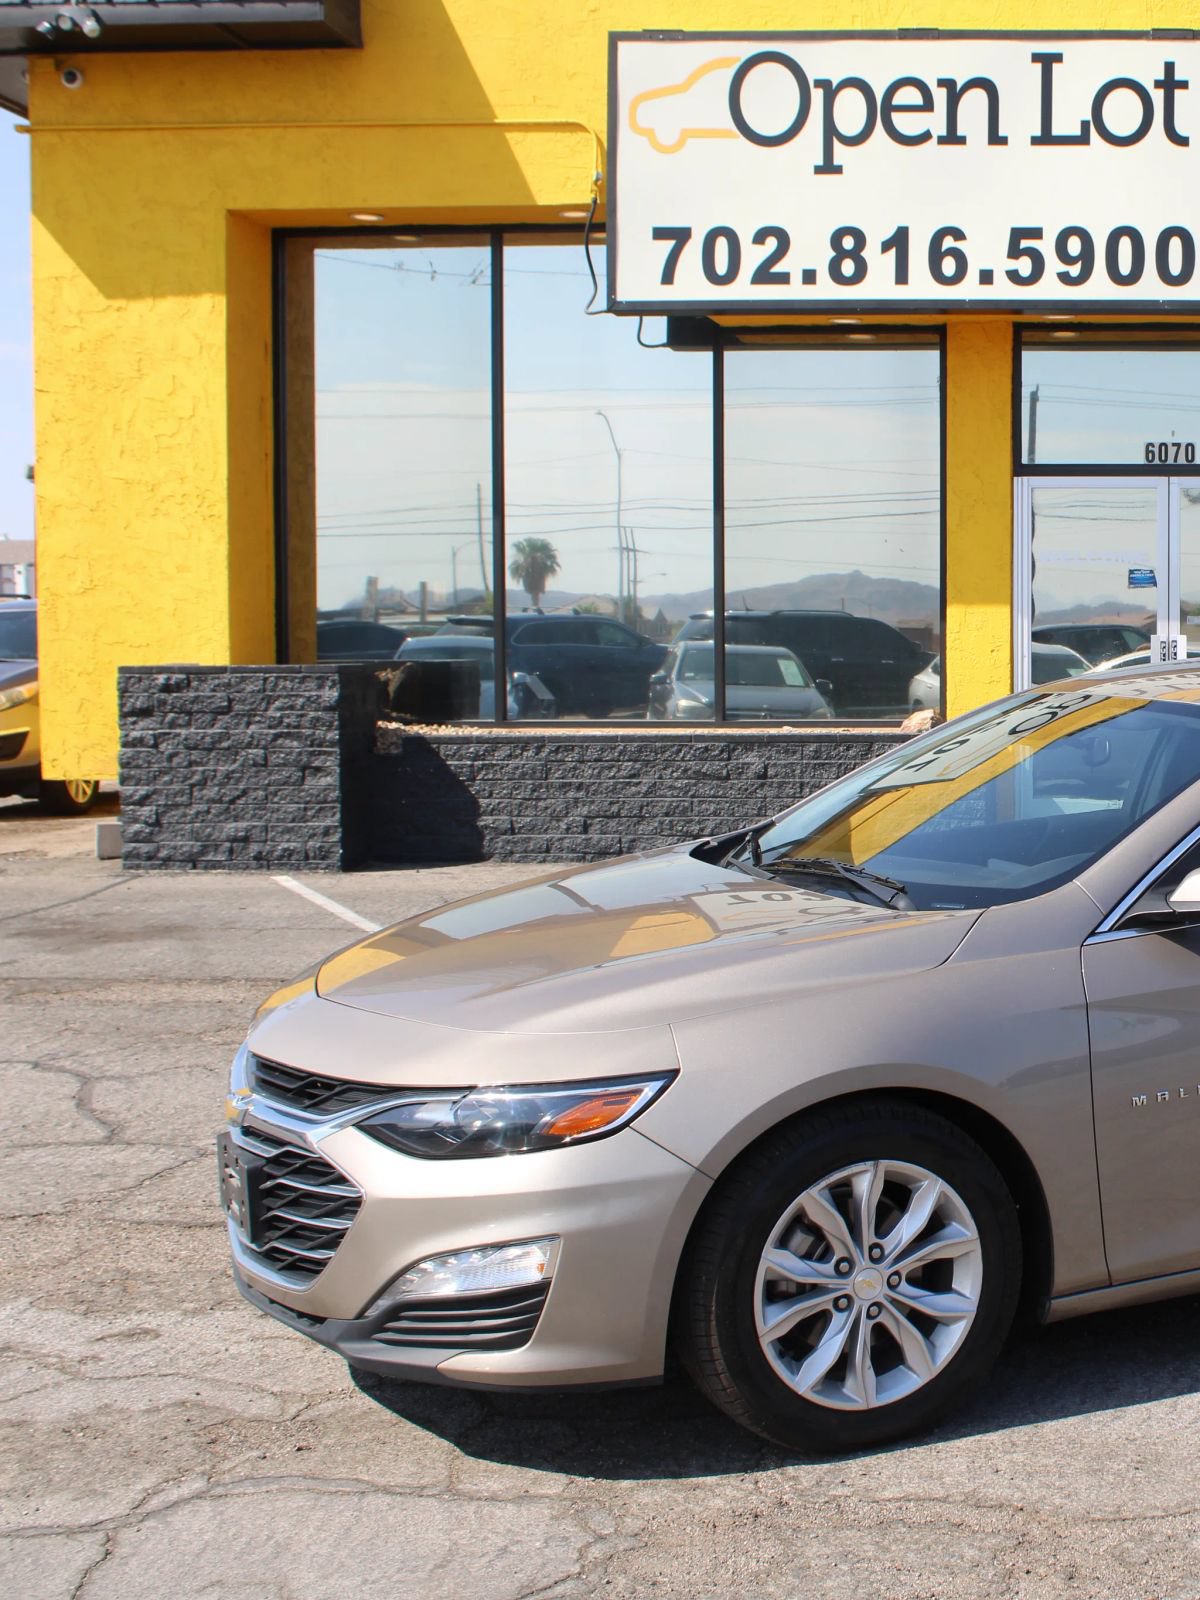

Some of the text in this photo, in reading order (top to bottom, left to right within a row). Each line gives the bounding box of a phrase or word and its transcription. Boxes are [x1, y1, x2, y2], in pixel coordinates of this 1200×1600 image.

[728, 51, 1008, 174] Open
[1030, 52, 1190, 147] Lot
[651, 226, 1196, 286] 702.816.5900
[1144, 442, 1196, 464] 6070
